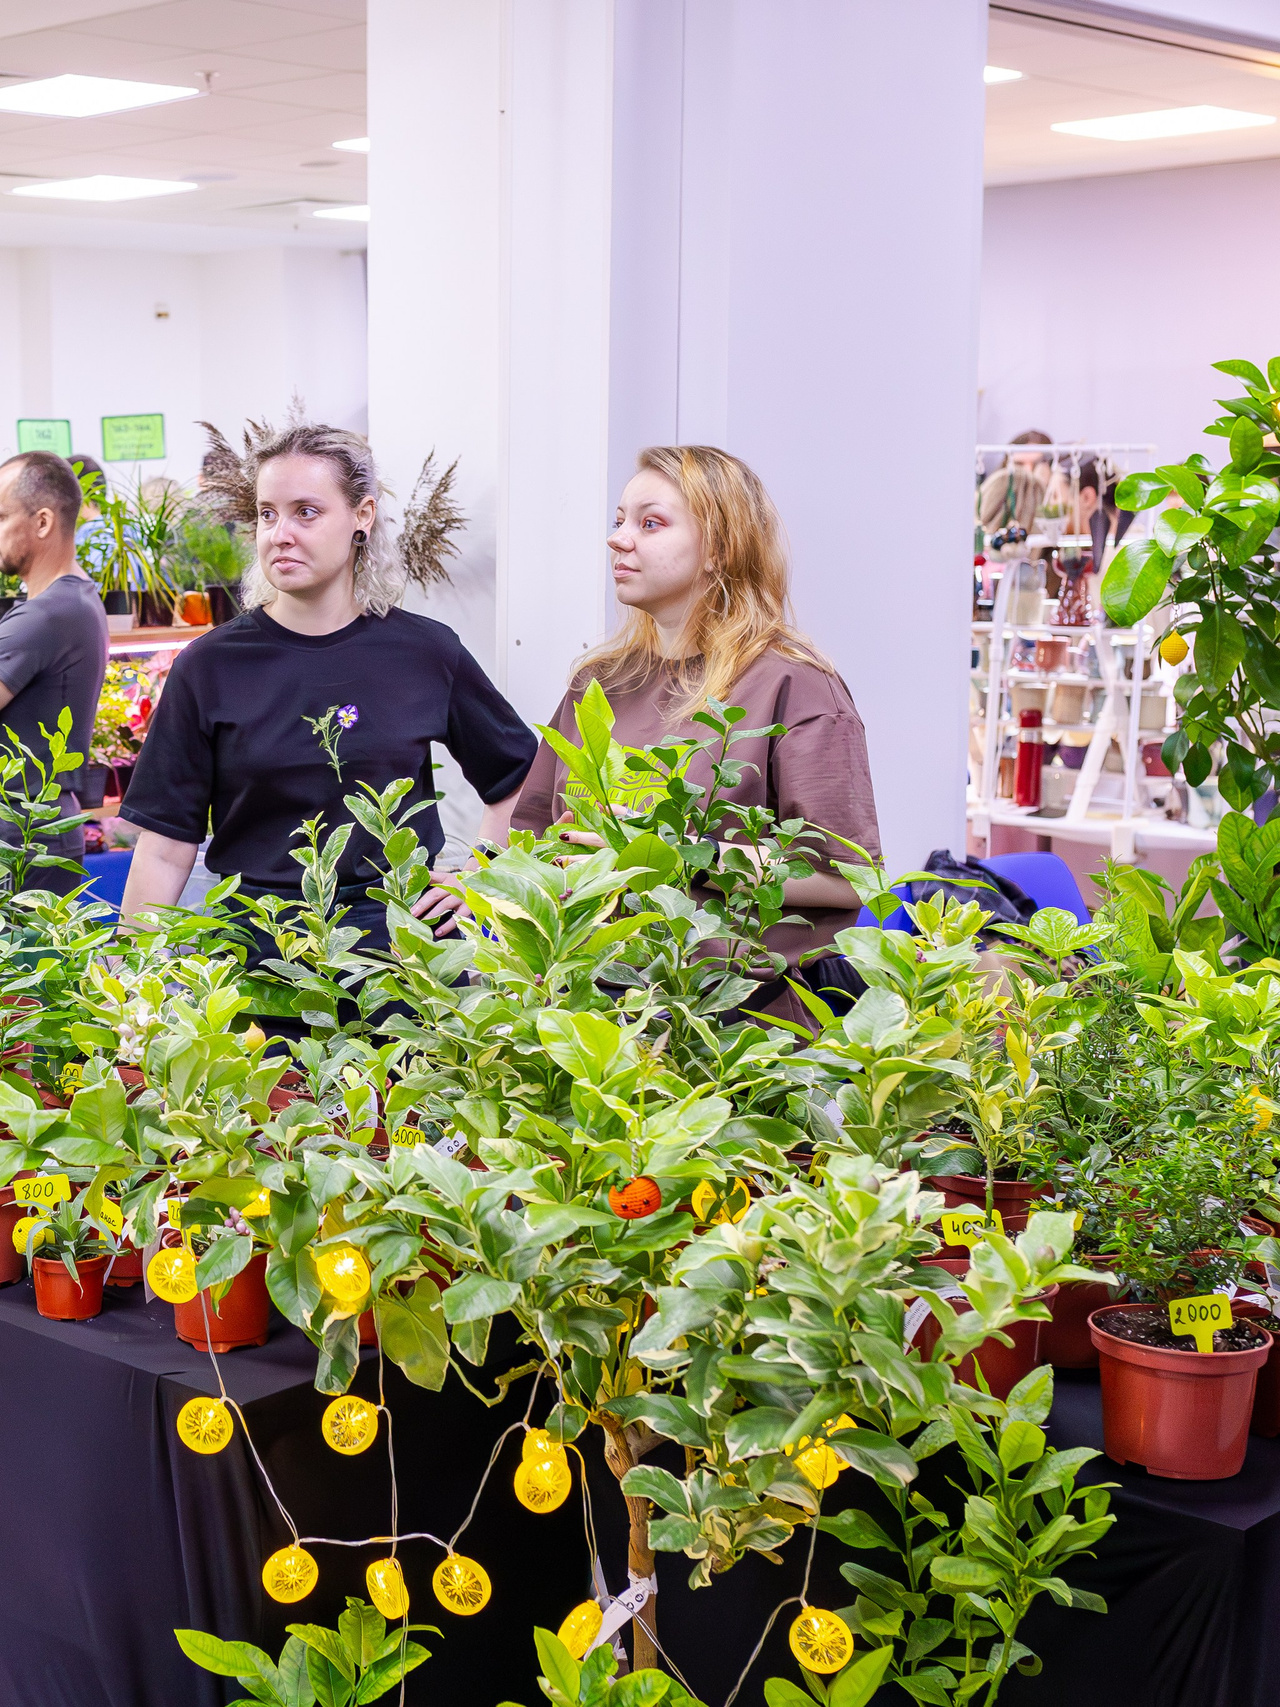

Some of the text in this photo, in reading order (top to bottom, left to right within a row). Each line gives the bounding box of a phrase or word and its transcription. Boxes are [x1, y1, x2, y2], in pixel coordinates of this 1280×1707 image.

[392, 1128, 421, 1146] 3000
[22, 1181, 54, 1200] 800
[1174, 1303, 1222, 1325] 2000
